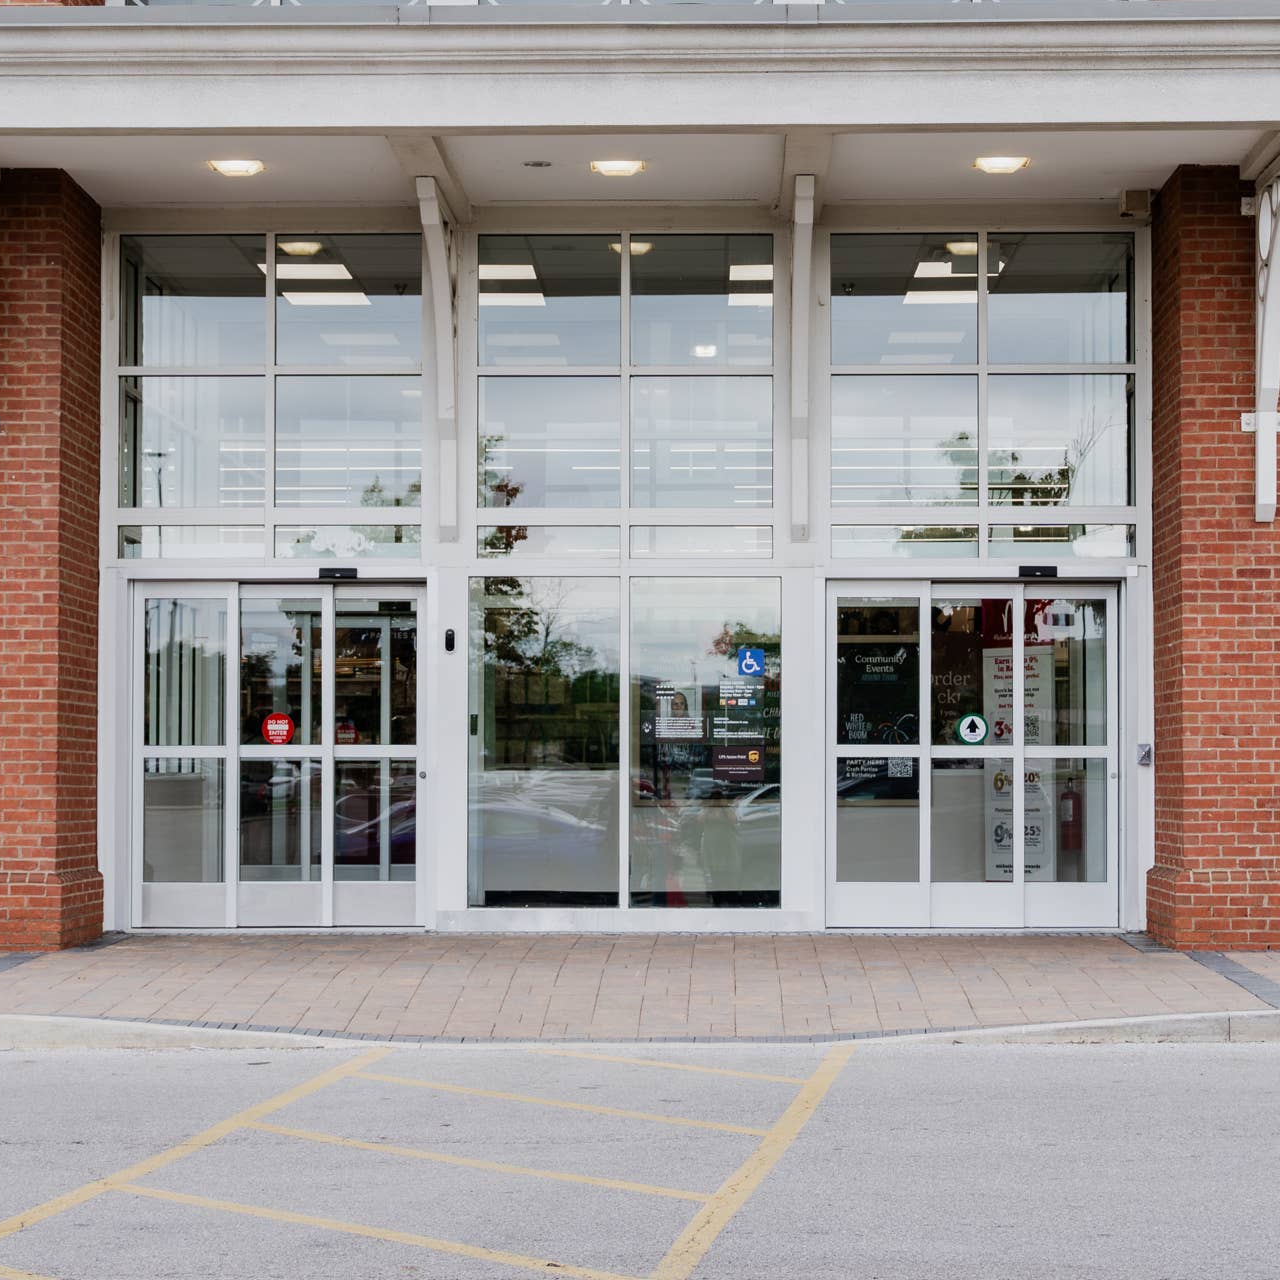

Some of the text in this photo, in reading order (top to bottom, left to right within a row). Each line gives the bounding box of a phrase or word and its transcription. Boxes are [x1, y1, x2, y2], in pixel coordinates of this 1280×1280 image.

[855, 654, 905, 665] Community
[994, 657, 1010, 665] Earn
[866, 664, 894, 673] Events
[994, 720, 1013, 738] 3%
